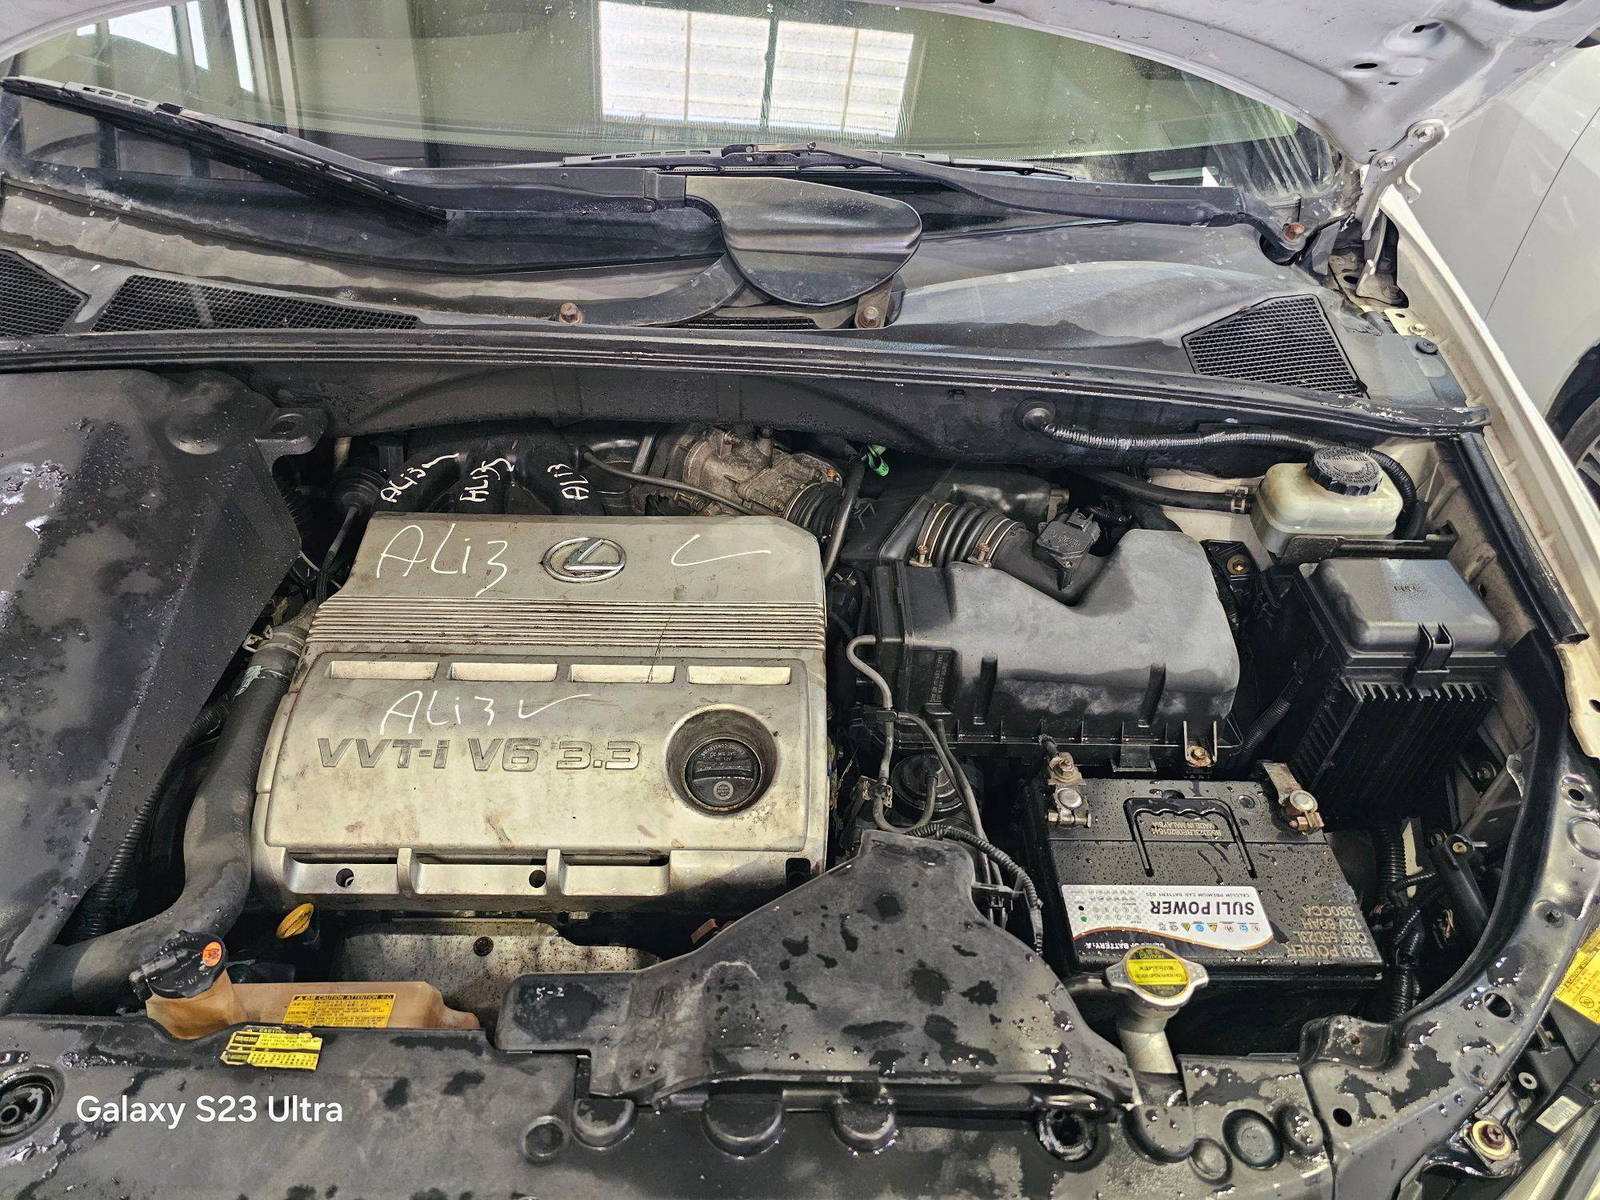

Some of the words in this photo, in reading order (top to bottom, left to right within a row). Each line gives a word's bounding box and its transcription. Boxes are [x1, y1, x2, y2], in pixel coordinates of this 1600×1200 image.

[317, 738, 450, 769] VVT-i
[468, 738, 541, 772] V6
[556, 740, 642, 771] 3.3
[1150, 901, 1211, 915] POWER
[1216, 901, 1255, 916] SULI
[1338, 918, 1362, 931] 12V
[1283, 943, 1340, 958] POWER
[1340, 945, 1375, 959] SULI
